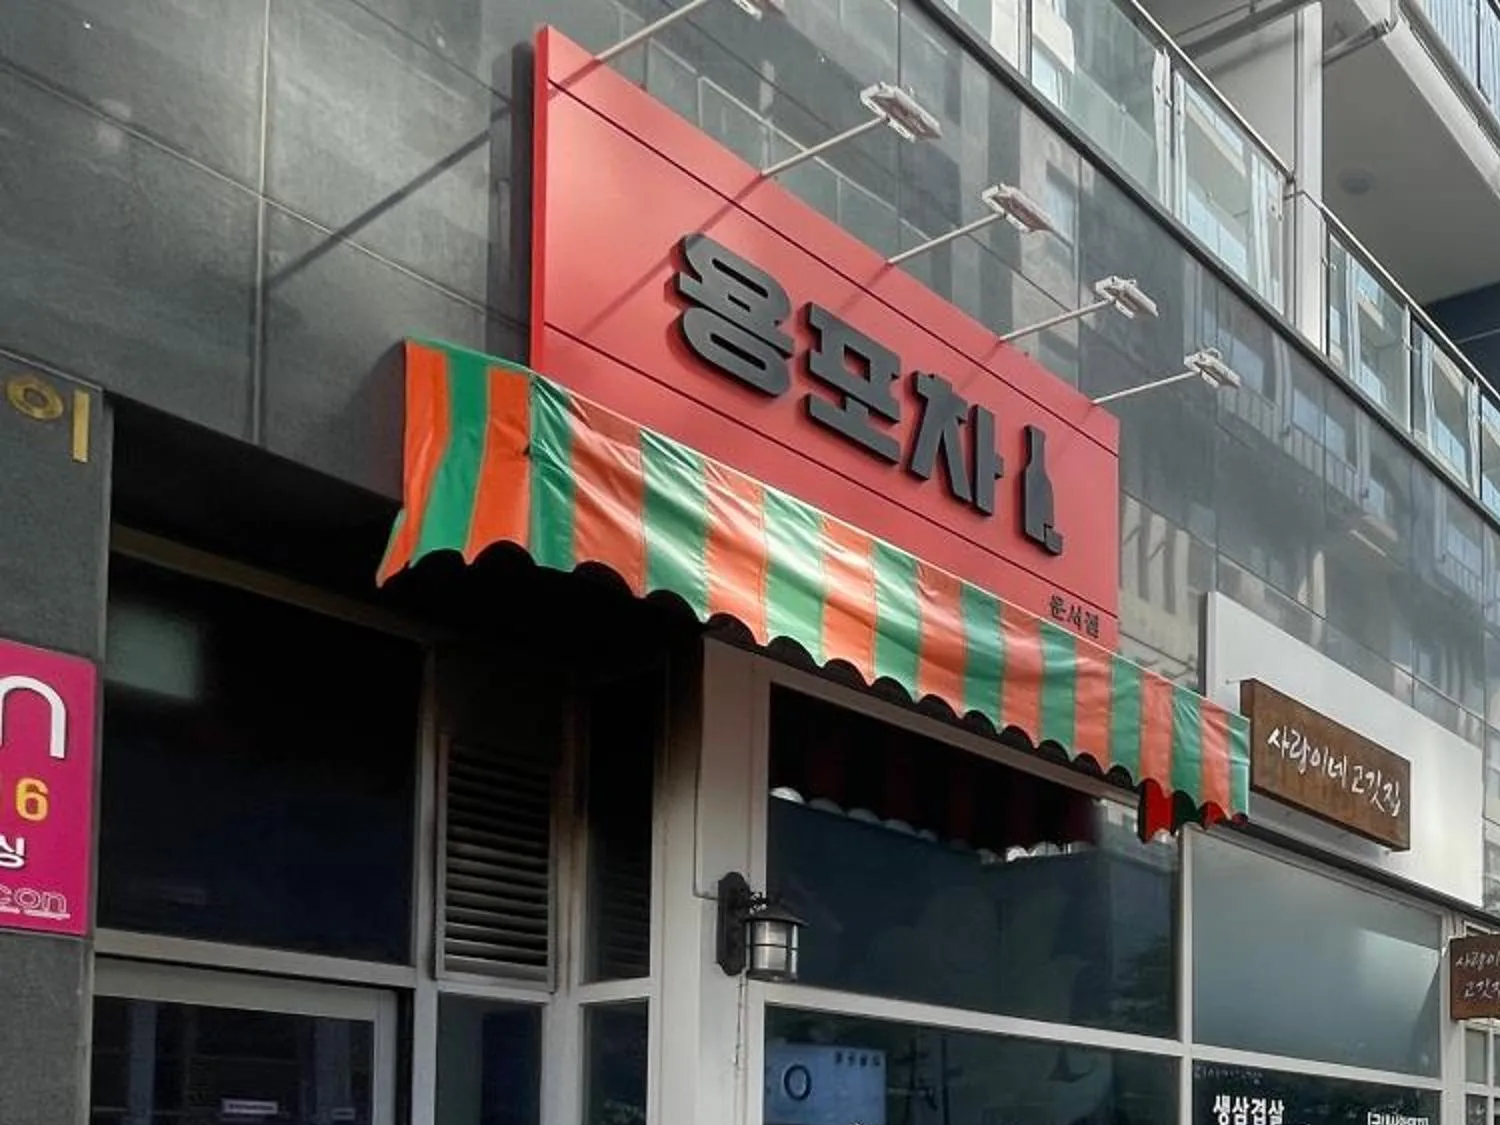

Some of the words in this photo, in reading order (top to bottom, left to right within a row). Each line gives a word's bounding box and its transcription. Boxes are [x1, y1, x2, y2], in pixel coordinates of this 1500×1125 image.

[676, 233, 1004, 518] 용포차
[1268, 725, 1347, 789] 사랑이네
[1351, 765, 1400, 817] 고깃집
